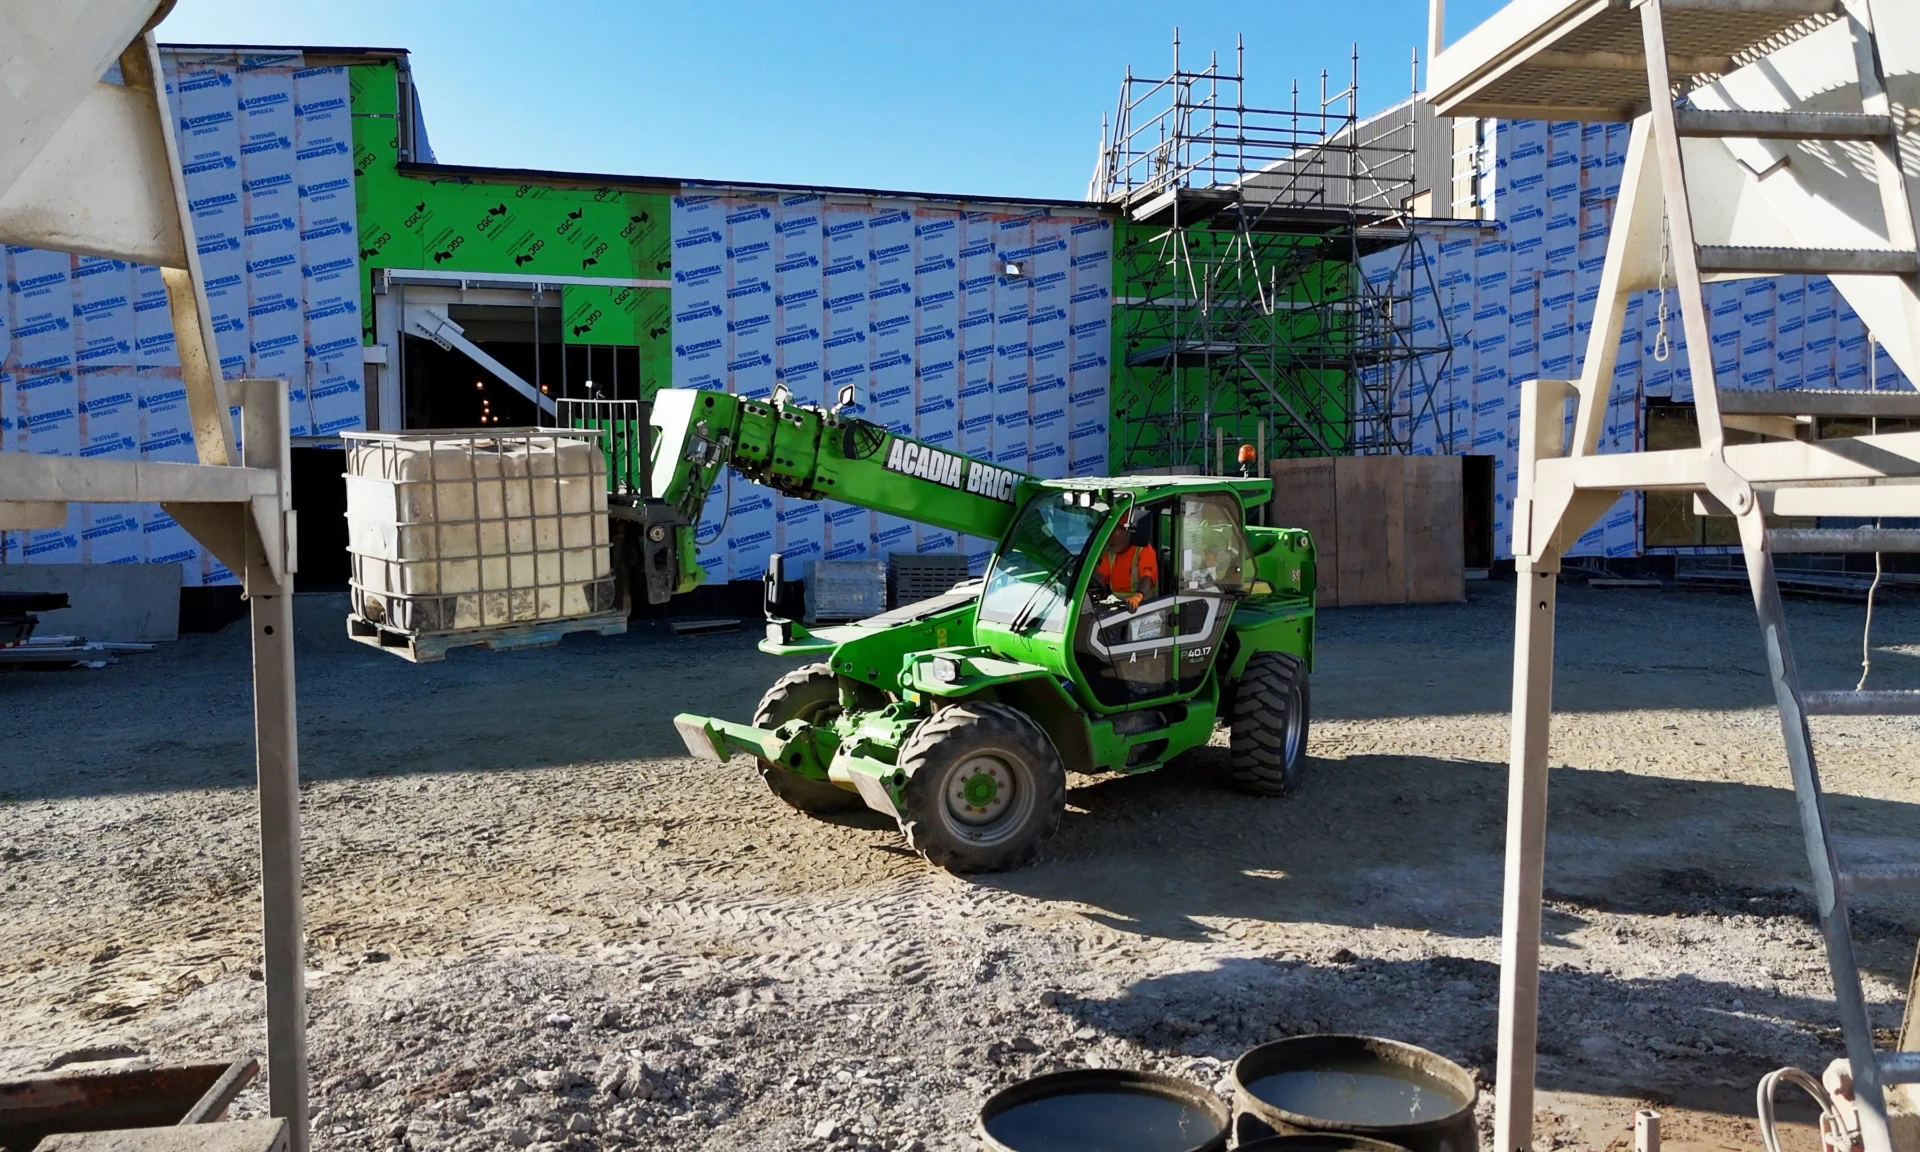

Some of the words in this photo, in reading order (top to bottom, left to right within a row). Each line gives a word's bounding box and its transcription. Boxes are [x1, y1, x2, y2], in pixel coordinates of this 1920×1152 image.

[245, 92, 288, 106] SOPREMA
[303, 97, 345, 112] SOPREMA
[249, 107, 275, 116] SOPRASEAL
[306, 112, 332, 122] SOPRASEAL
[189, 111, 233, 125] SOPREMA
[192, 126, 219, 136] SOPRASEAL
[249, 131, 276, 141] SOPRASEAL
[307, 137, 333, 147] SOPRASEAL
[194, 150, 221, 160] SOPRASEAL
[362, 152, 376, 169] CGC
[249, 173, 292, 188] SOPREMA
[307, 178, 349, 193] SOPREMA
[252, 188, 279, 198] SOPRASEAL
[310, 193, 337, 203] SOPRASEAL
[193, 193, 237, 208] SOPREMA
[196, 208, 224, 218] SOPRASEAL
[253, 212, 280, 222] SOPRASEAL
[312, 217, 338, 227] SOPRASEAL
[404, 212, 421, 229] CGC
[477, 215, 494, 232] CGC
[782, 216, 817, 228] SOPREMA
[830, 220, 864, 233] SOPREMA
[870, 216, 901, 227] SOPREMA
[921, 220, 955, 232] SOPREMA
[557, 219, 573, 236] CGC
[620, 221, 636, 239] CGC
[376, 232, 391, 249] CGC
[447, 235, 465, 252] CGC
[677, 236, 712, 249] SOPREMA
[528, 239, 545, 255] CGC
[592, 241, 608, 259] CGC
[734, 242, 769, 254] SOPREMA
[876, 244, 910, 256] SOPREMA
[252, 254, 295, 268] SOPREMA
[1076, 251, 1108, 264] SOPREMA
[311, 258, 354, 272] SOPREMA
[685, 265, 722, 277] SOPREMA
[19, 272, 64, 287] SOPREMA
[255, 269, 282, 279] SOPRASEAL
[315, 273, 341, 282] SOPRASEAL
[1034, 271, 1065, 283] SOPREMA
[23, 288, 51, 298] SOPRASEAL
[256, 293, 283, 303] SOPRASEAL
[613, 287, 631, 306] CGC
[783, 289, 818, 301] SOPREMA
[830, 292, 864, 304] SOPREMA
[922, 291, 955, 303] SOPREMA
[81, 296, 126, 311] SOPREMA
[316, 296, 342, 306] SOPRASEAL
[25, 312, 53, 323] SOPRASEAL
[86, 311, 113, 322] SOPRASEAL
[304, 307, 345, 321] SOPREMA
[585, 309, 602, 325] CGC
[677, 309, 713, 323] SOPREMA
[735, 314, 770, 327] SOPREMA
[876, 315, 910, 328] SOPREMA
[1075, 320, 1106, 331] SOPREMA
[11, 322, 57, 338] SOPREMA
[86, 336, 114, 347] SOPRASEAL
[256, 334, 298, 348] SOPREMA
[316, 337, 357, 351] SOPREMA
[685, 339, 722, 351] SOPREMA
[1033, 340, 1065, 353] SOPREMA
[143, 346, 171, 356] SOPRASEAL
[259, 349, 285, 359] SOPRASEAL
[783, 361, 818, 374] SOPREMA
[831, 363, 864, 376] SOPREMA
[921, 361, 954, 373] SOPREMA
[877, 386, 910, 399] SOPREMA
[1074, 387, 1105, 399] SOPREMA
[87, 392, 132, 407] SOPREMA
[26, 408, 72, 423] SOPREMA
[91, 407, 119, 418] SOPRASEAL
[1033, 409, 1064, 420] SOPREMA
[31, 423, 59, 434] SOPRASEAL
[318, 416, 359, 431] SOPREMA
[92, 432, 120, 443] SOPRASEAL
[150, 428, 178, 439] SOPRASEAL
[887, 438, 963, 488] ACADIA
[1073, 455, 1104, 467] SOPREMA
[784, 503, 820, 517] SOPREMA
[831, 506, 865, 518] SOPREMA
[95, 514, 123, 525] SOPRASEAL
[33, 531, 62, 542] SOPRASEAL
[736, 530, 771, 543] SOPREMA
